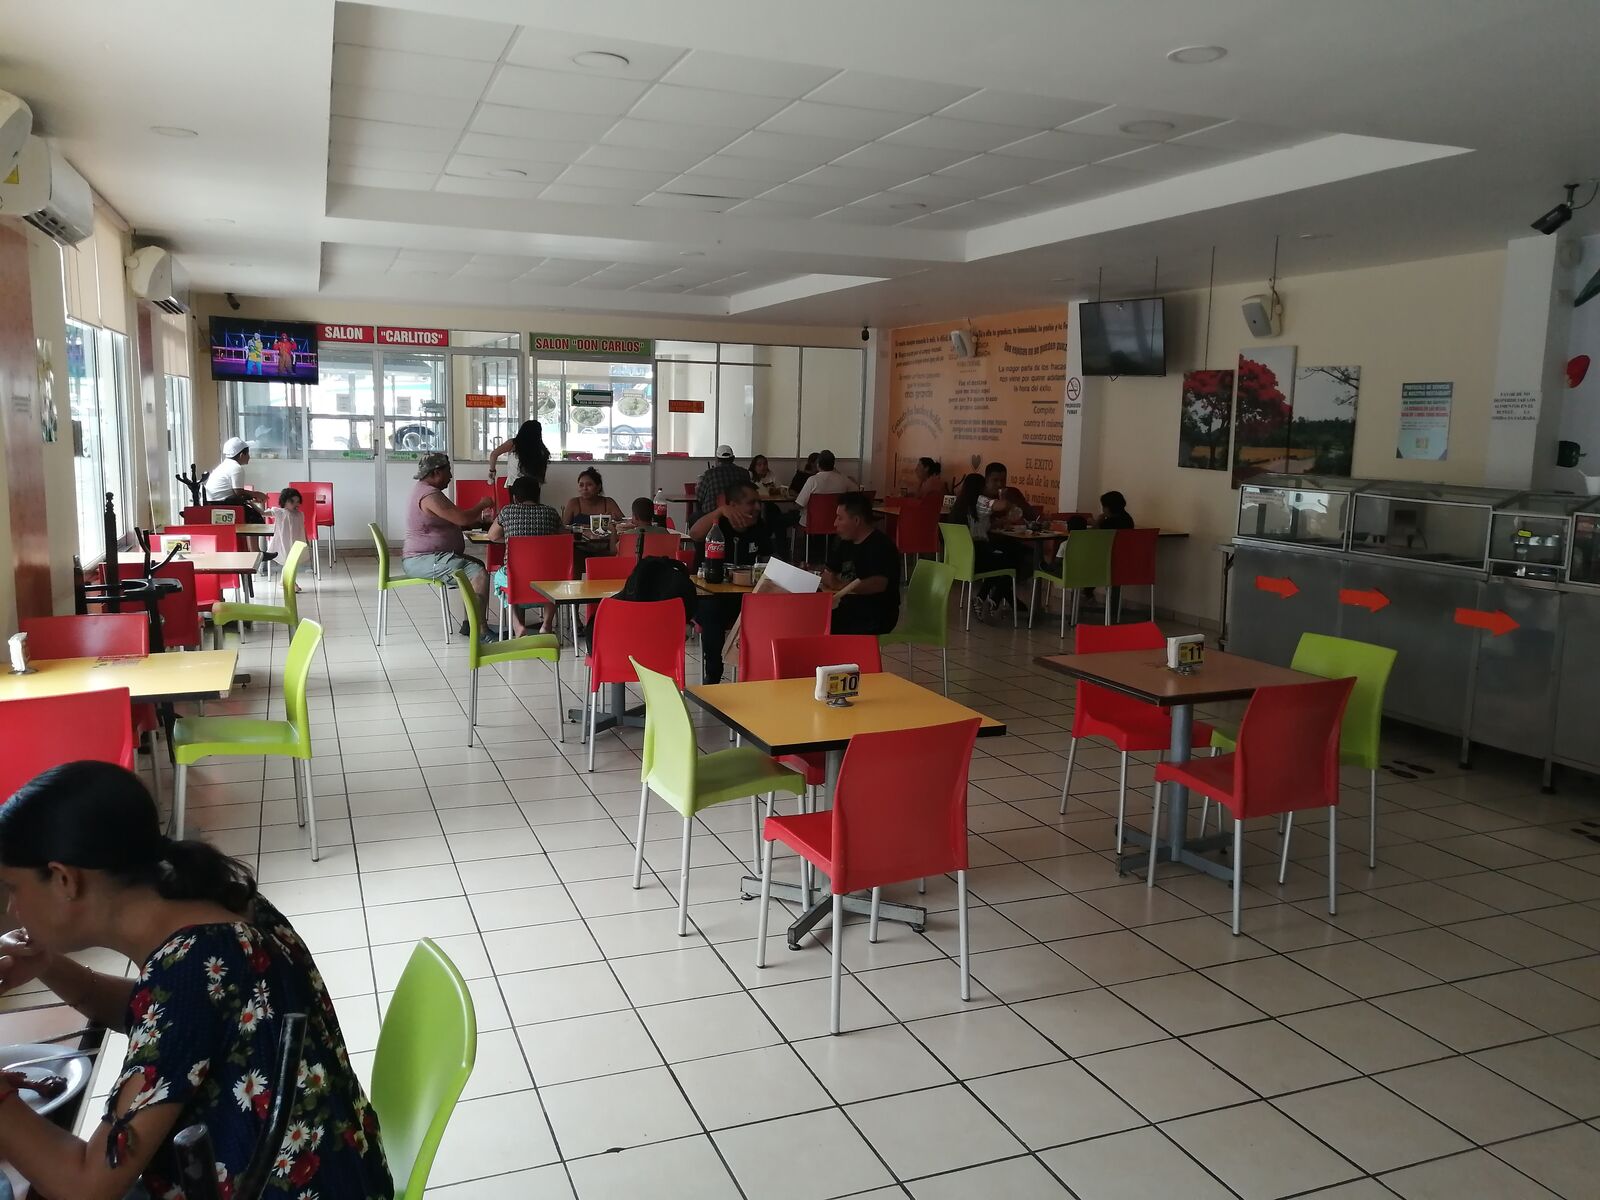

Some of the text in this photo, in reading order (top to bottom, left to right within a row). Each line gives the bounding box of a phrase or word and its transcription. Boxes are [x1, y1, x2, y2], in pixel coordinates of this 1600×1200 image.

[325, 326, 443, 344] SALON "CARLITOS"
[536, 338, 569, 350] SALON
[1025, 458, 1033, 469] EL
[222, 513, 233, 523] 05
[1189, 645, 1202, 661] 11
[840, 675, 858, 692] 10
